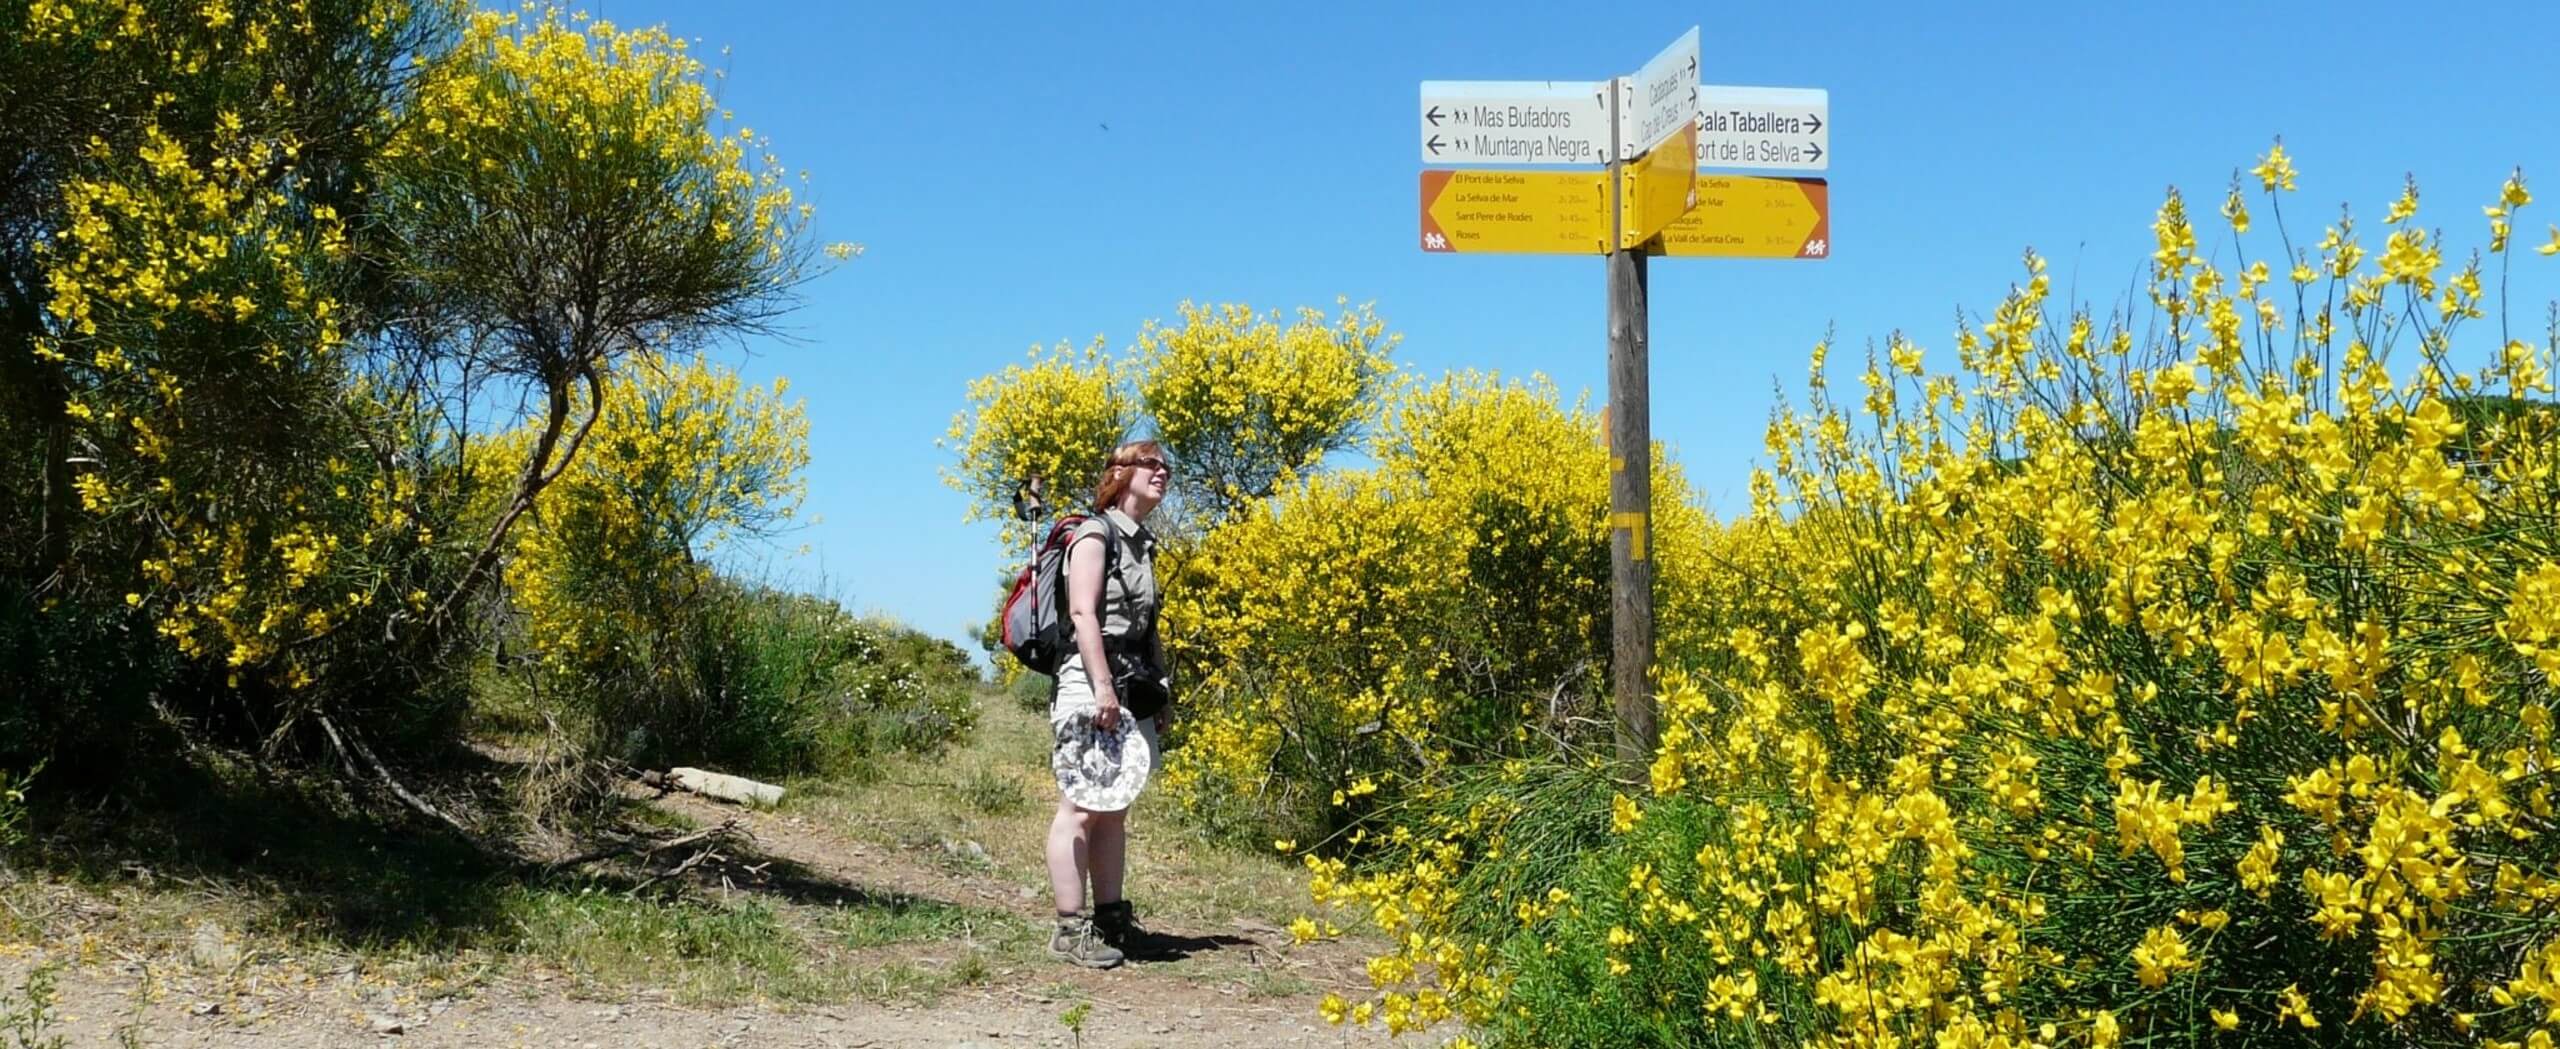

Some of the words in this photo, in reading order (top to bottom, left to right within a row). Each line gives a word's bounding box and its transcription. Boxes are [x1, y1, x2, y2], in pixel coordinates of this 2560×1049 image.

[1474, 106, 1504, 128] Mas
[1508, 106, 1570, 128] Bufadors
[1696, 110, 1727, 132] Cala
[1730, 111, 1799, 133] Taballera
[1475, 135, 1543, 161] Muntanya
[1548, 135, 1590, 161] Negra
[1696, 140, 1716, 160] ort
[1720, 140, 1738, 160] de
[1743, 140, 1756, 161] la
[1760, 140, 1800, 162] Selva
[1464, 174, 1481, 184] Port
[1482, 174, 1493, 184] de
[1495, 174, 1502, 184] la
[1503, 174, 1525, 184] Selva
[1709, 178, 1730, 188] Selva
[1456, 193, 1465, 202] La
[1467, 193, 1488, 202] Selva
[1490, 193, 1500, 202] de
[1502, 193, 1518, 202] Mar
[1708, 197, 1724, 207] Mar
[1456, 211, 1474, 221] Sant
[1476, 212, 1494, 221] Pere
[1495, 212, 1506, 222] de
[1507, 212, 1533, 222] Rodes
[1456, 230, 1480, 240] Roses
[1688, 234, 1700, 243] de
[1702, 233, 1723, 243] Santa
[1724, 234, 1744, 244] Creu
